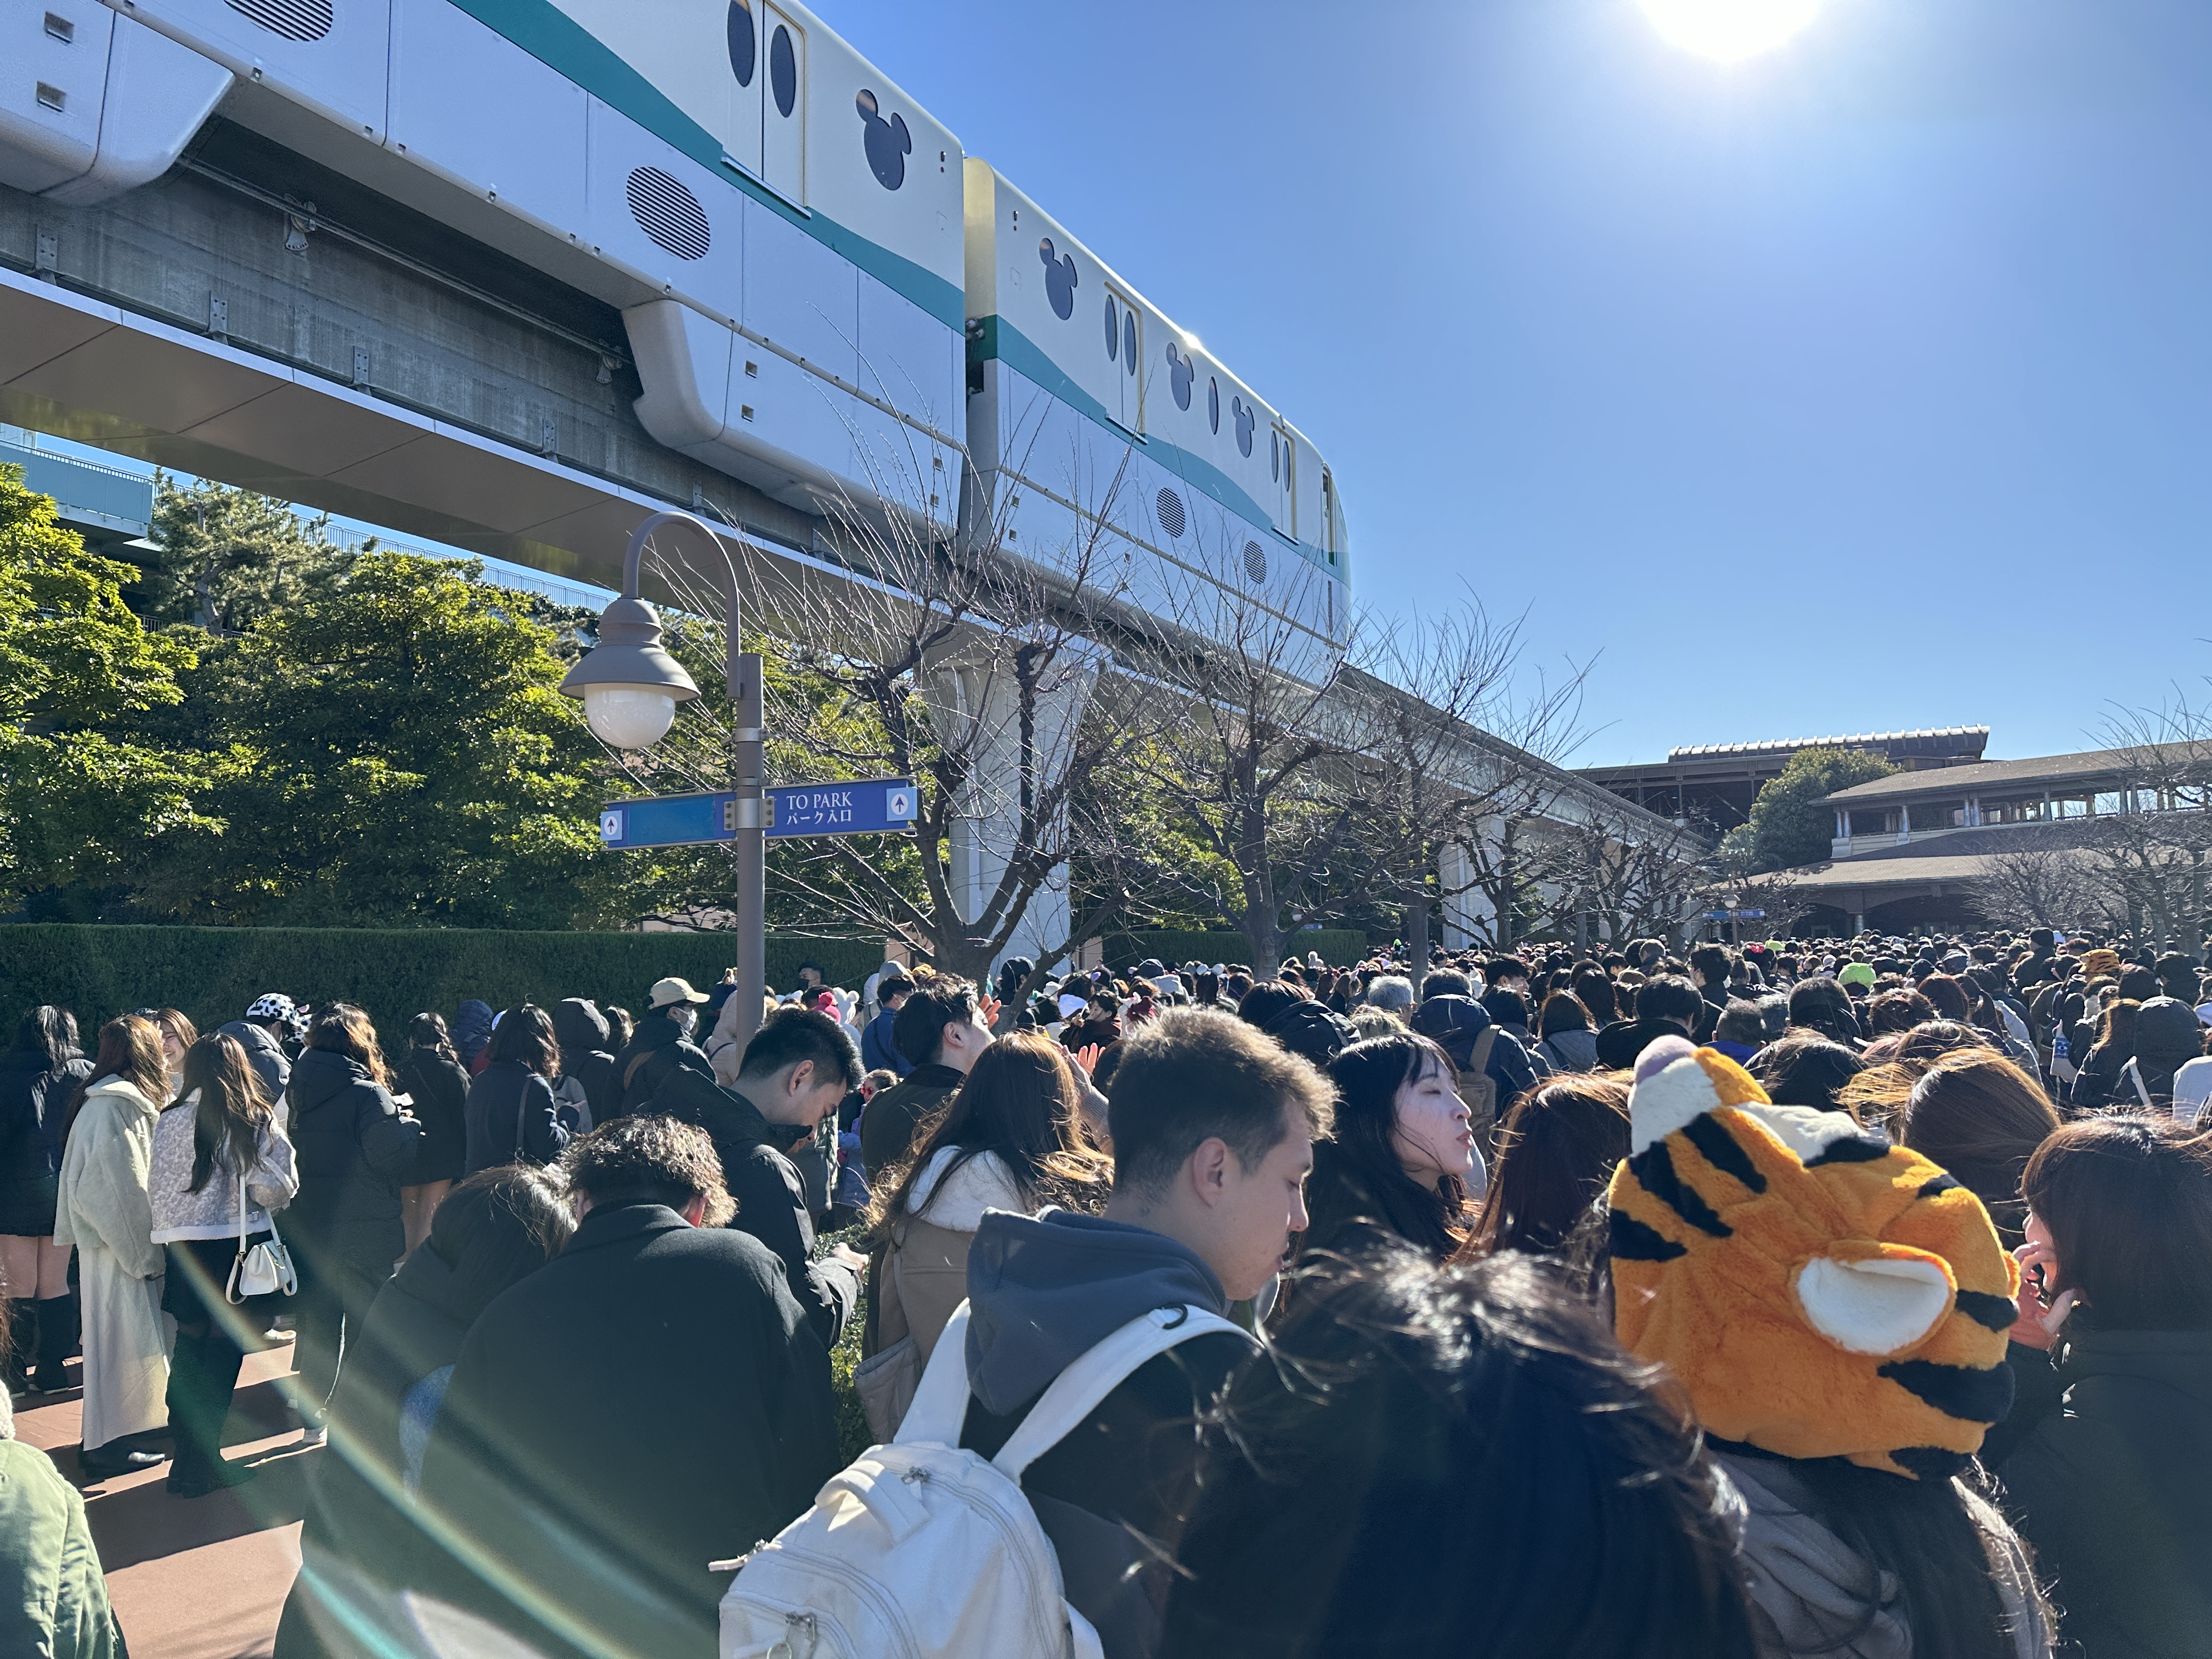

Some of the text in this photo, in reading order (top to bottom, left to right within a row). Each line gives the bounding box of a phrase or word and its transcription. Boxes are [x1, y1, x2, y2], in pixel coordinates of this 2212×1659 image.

[786, 792, 853, 810] TO PARK
[786, 809, 851, 825] パーク入口
